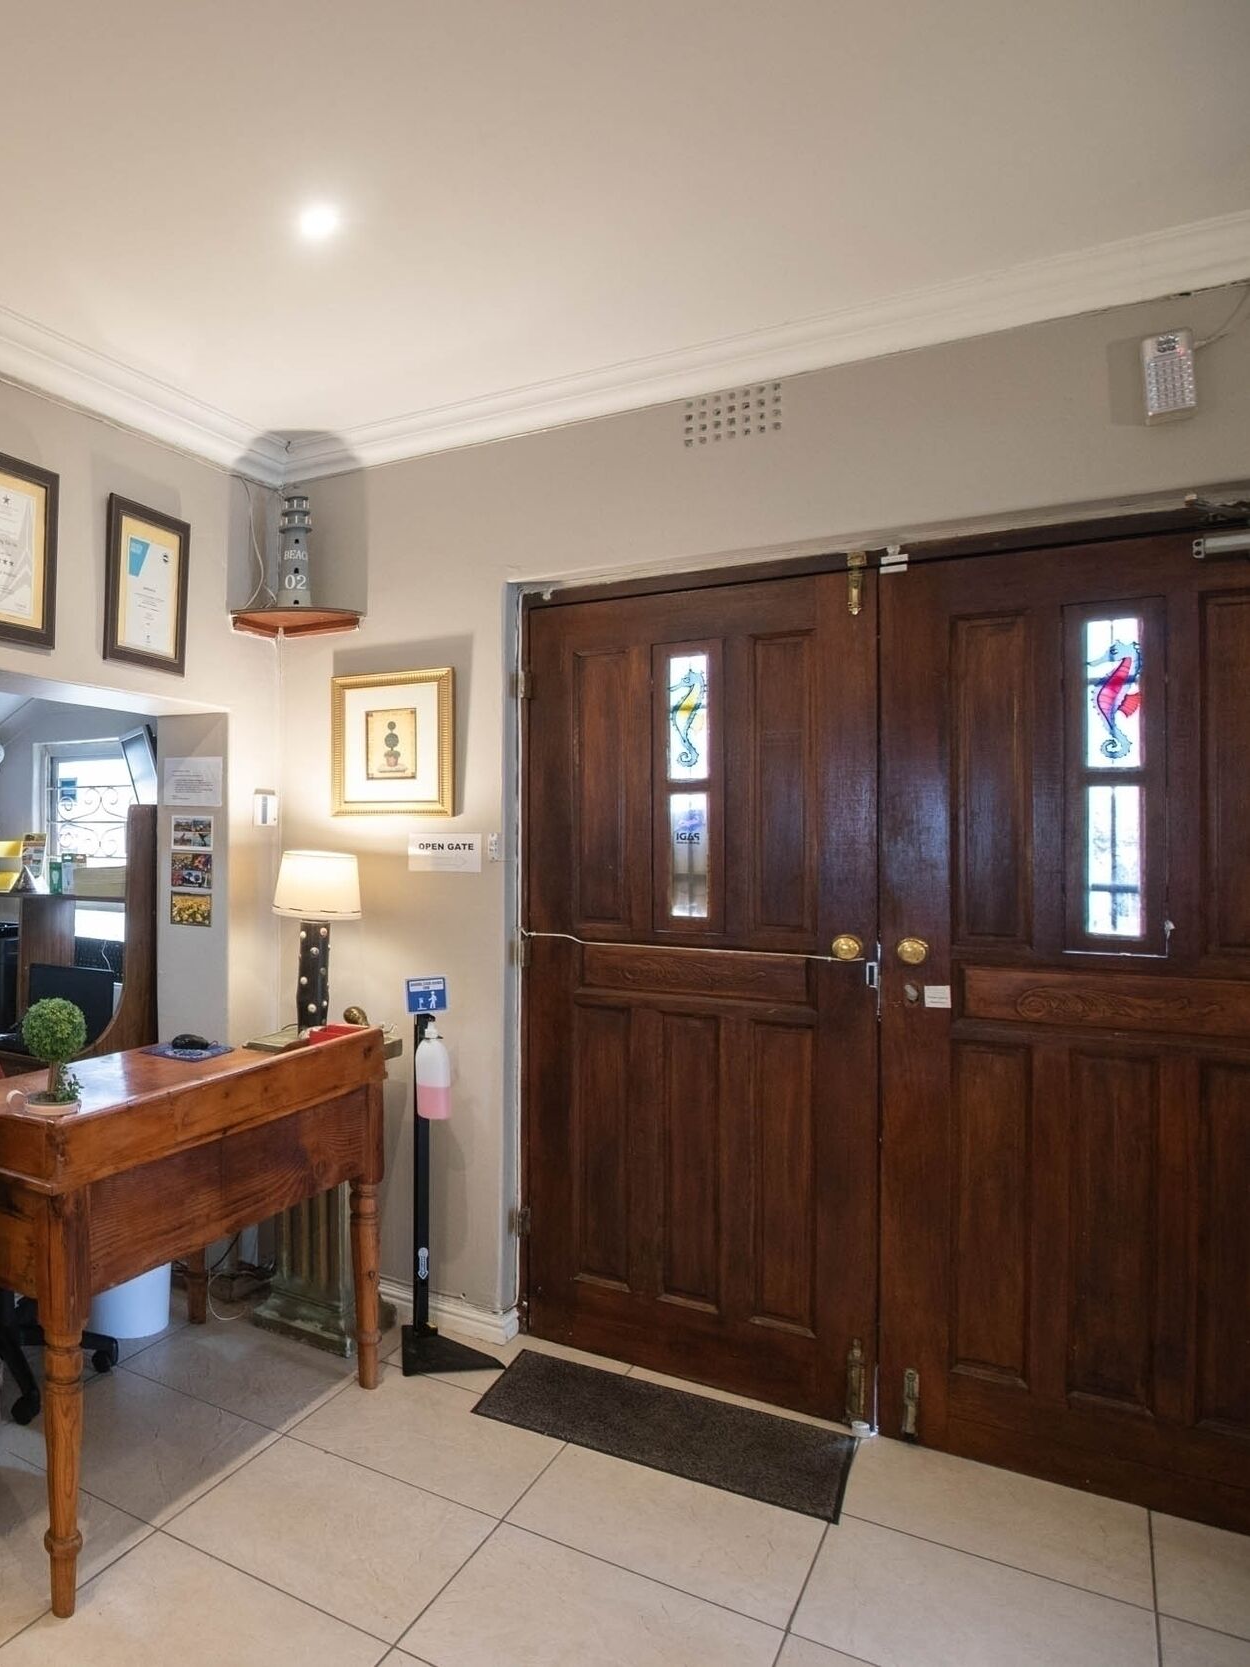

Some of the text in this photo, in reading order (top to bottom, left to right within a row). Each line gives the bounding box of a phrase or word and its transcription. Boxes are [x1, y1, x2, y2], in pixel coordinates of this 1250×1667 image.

[284, 574, 307, 590] 02
[418, 842, 474, 851] OPEN GATE
